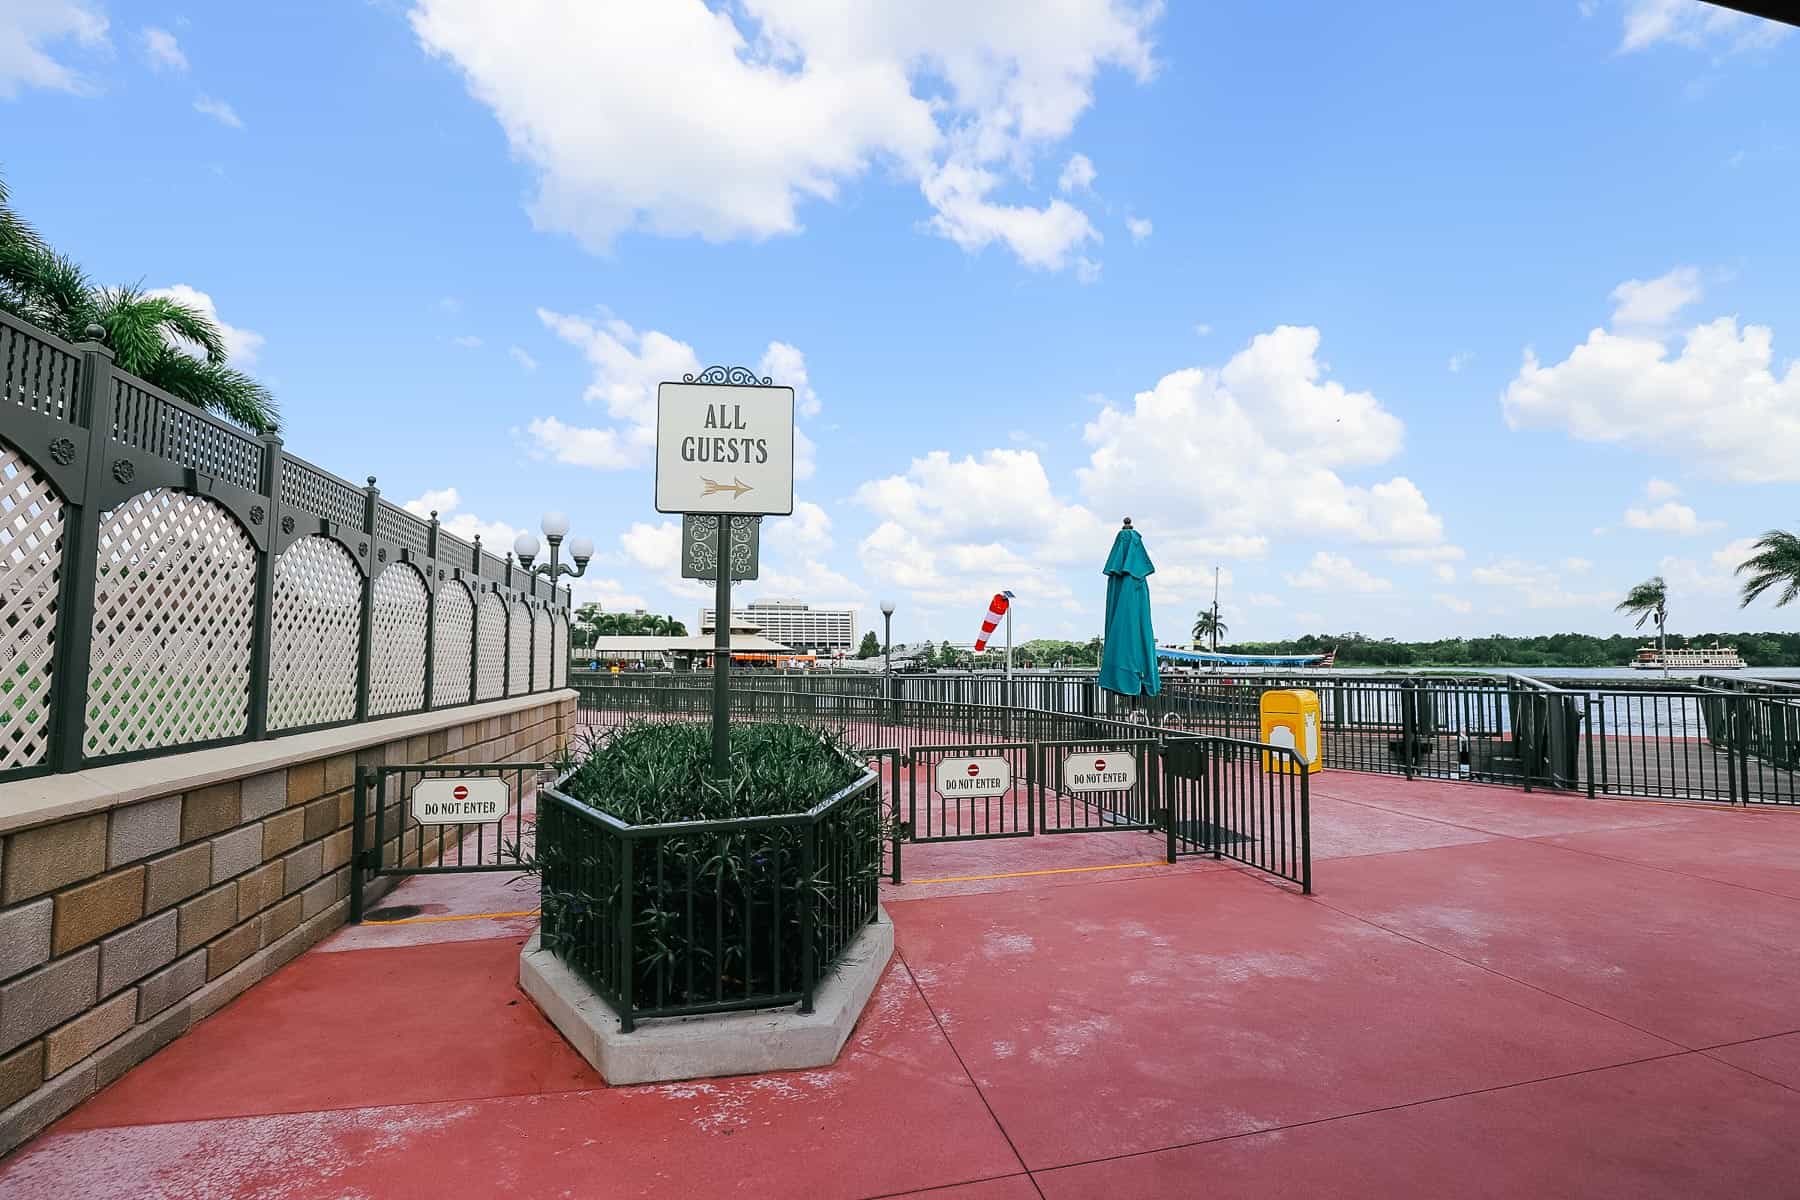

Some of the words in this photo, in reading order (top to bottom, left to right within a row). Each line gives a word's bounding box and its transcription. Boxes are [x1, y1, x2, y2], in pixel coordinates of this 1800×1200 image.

[704, 404, 747, 430] ALL
[681, 436, 768, 464] GUESTS
[946, 779, 957, 790] DO
[958, 779, 975, 790] NOT
[976, 778, 1001, 789] ENTER
[1074, 774, 1085, 785] DO
[1086, 773, 1101, 784] NOT
[1103, 772, 1128, 783] ENTER
[425, 803, 438, 815] DO
[441, 802, 461, 815] NOT
[464, 801, 496, 814] ENTER
